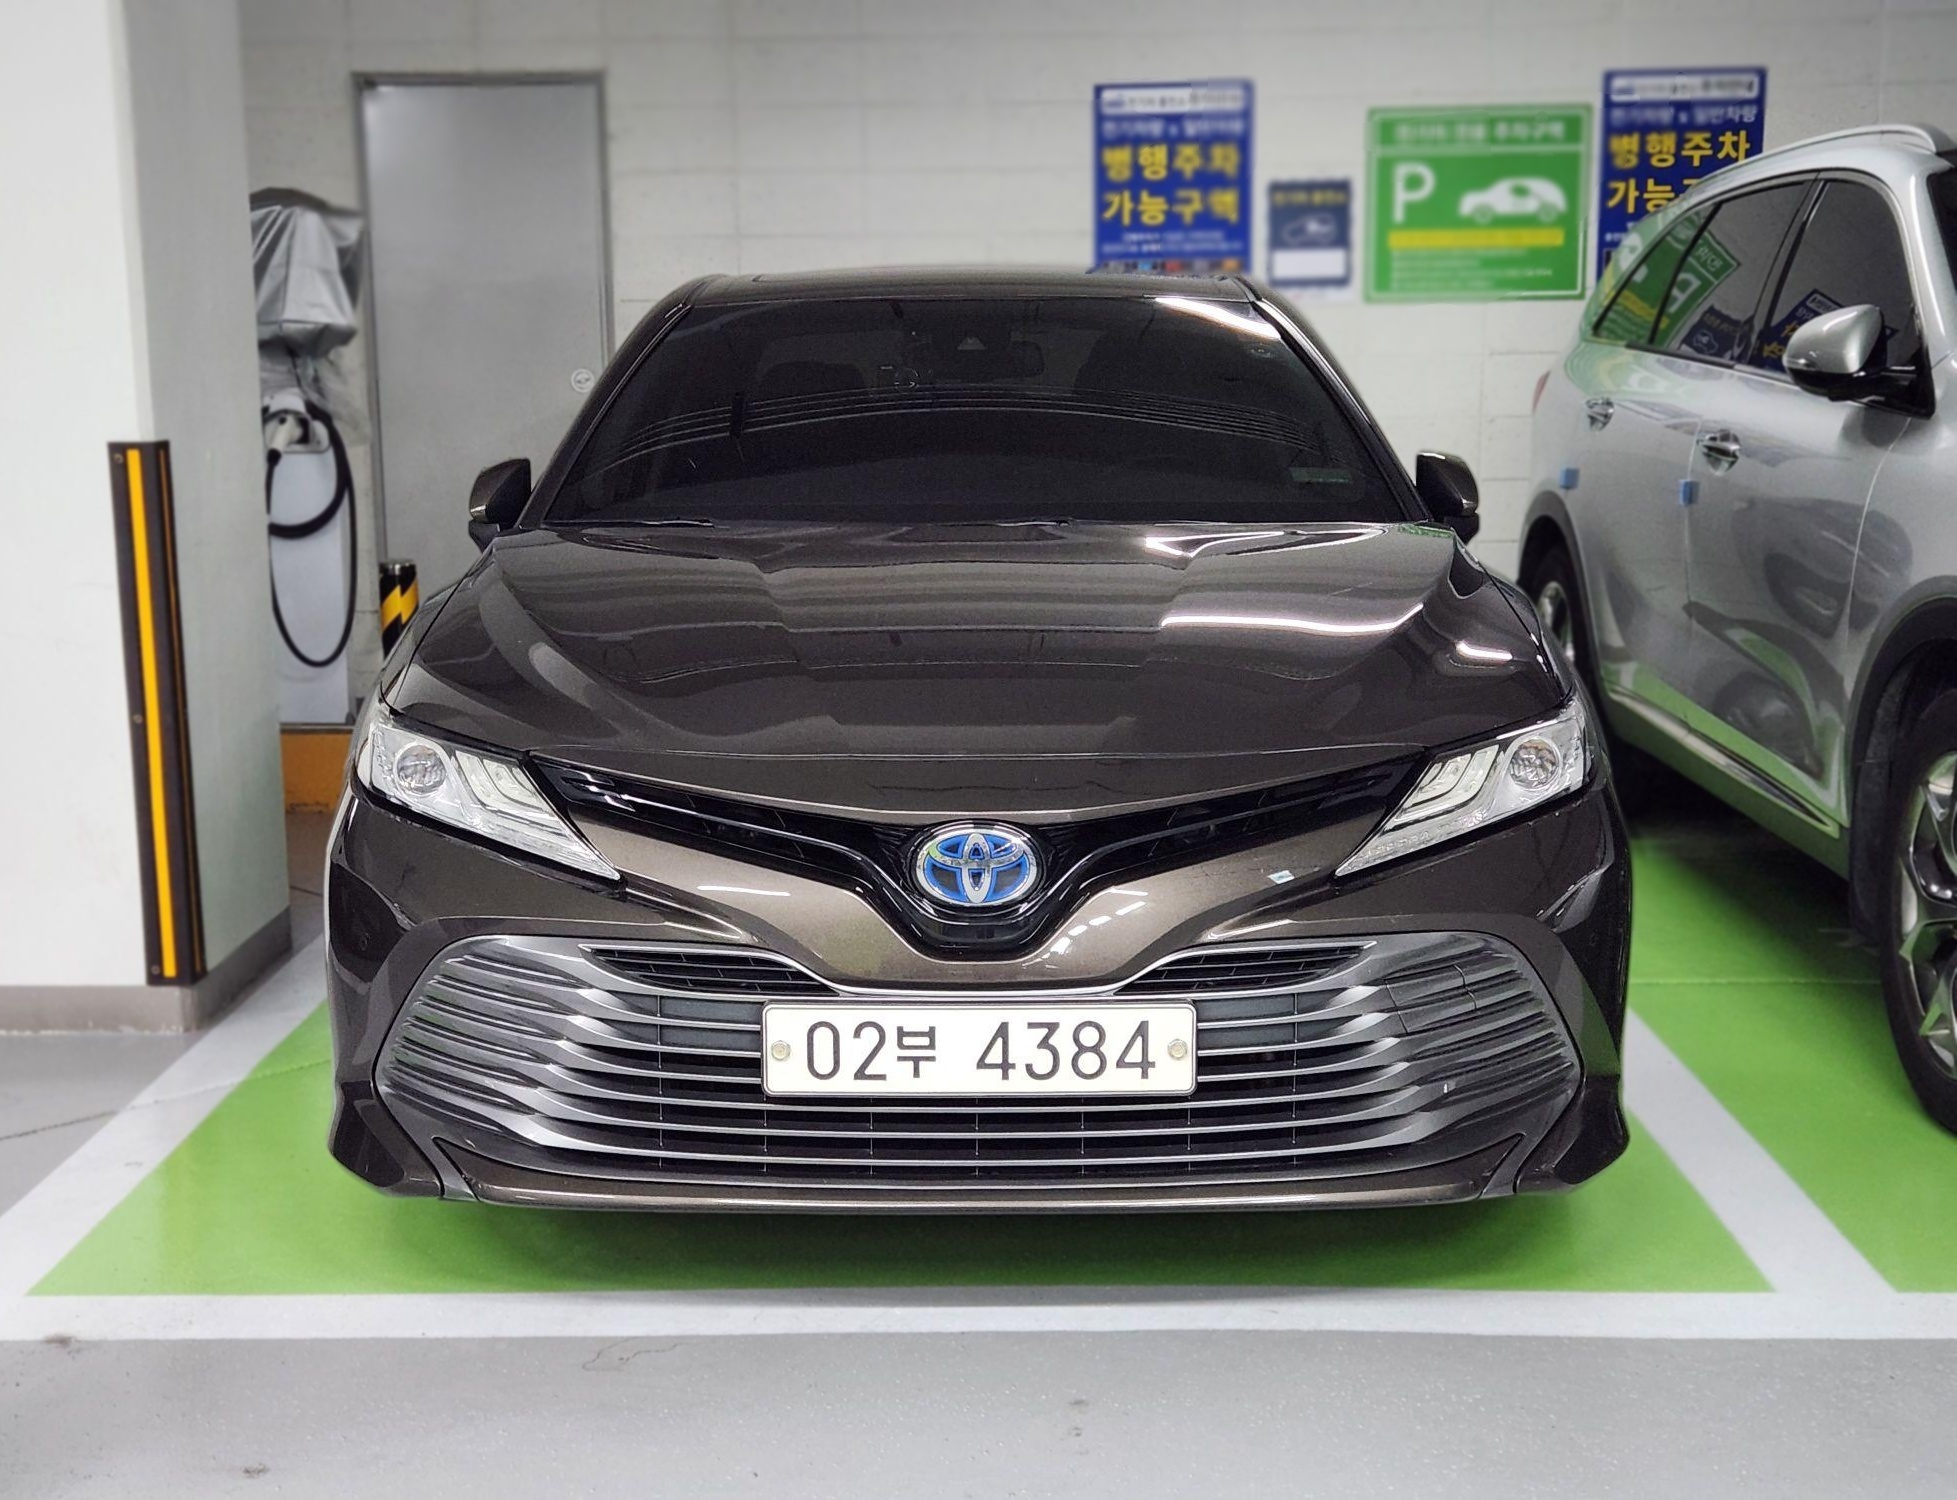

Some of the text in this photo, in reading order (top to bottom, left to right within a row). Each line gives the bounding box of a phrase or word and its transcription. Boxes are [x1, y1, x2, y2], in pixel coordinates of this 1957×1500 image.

[1393, 163, 1435, 223] P
[806, 1020, 1156, 1081] 02부 4384
